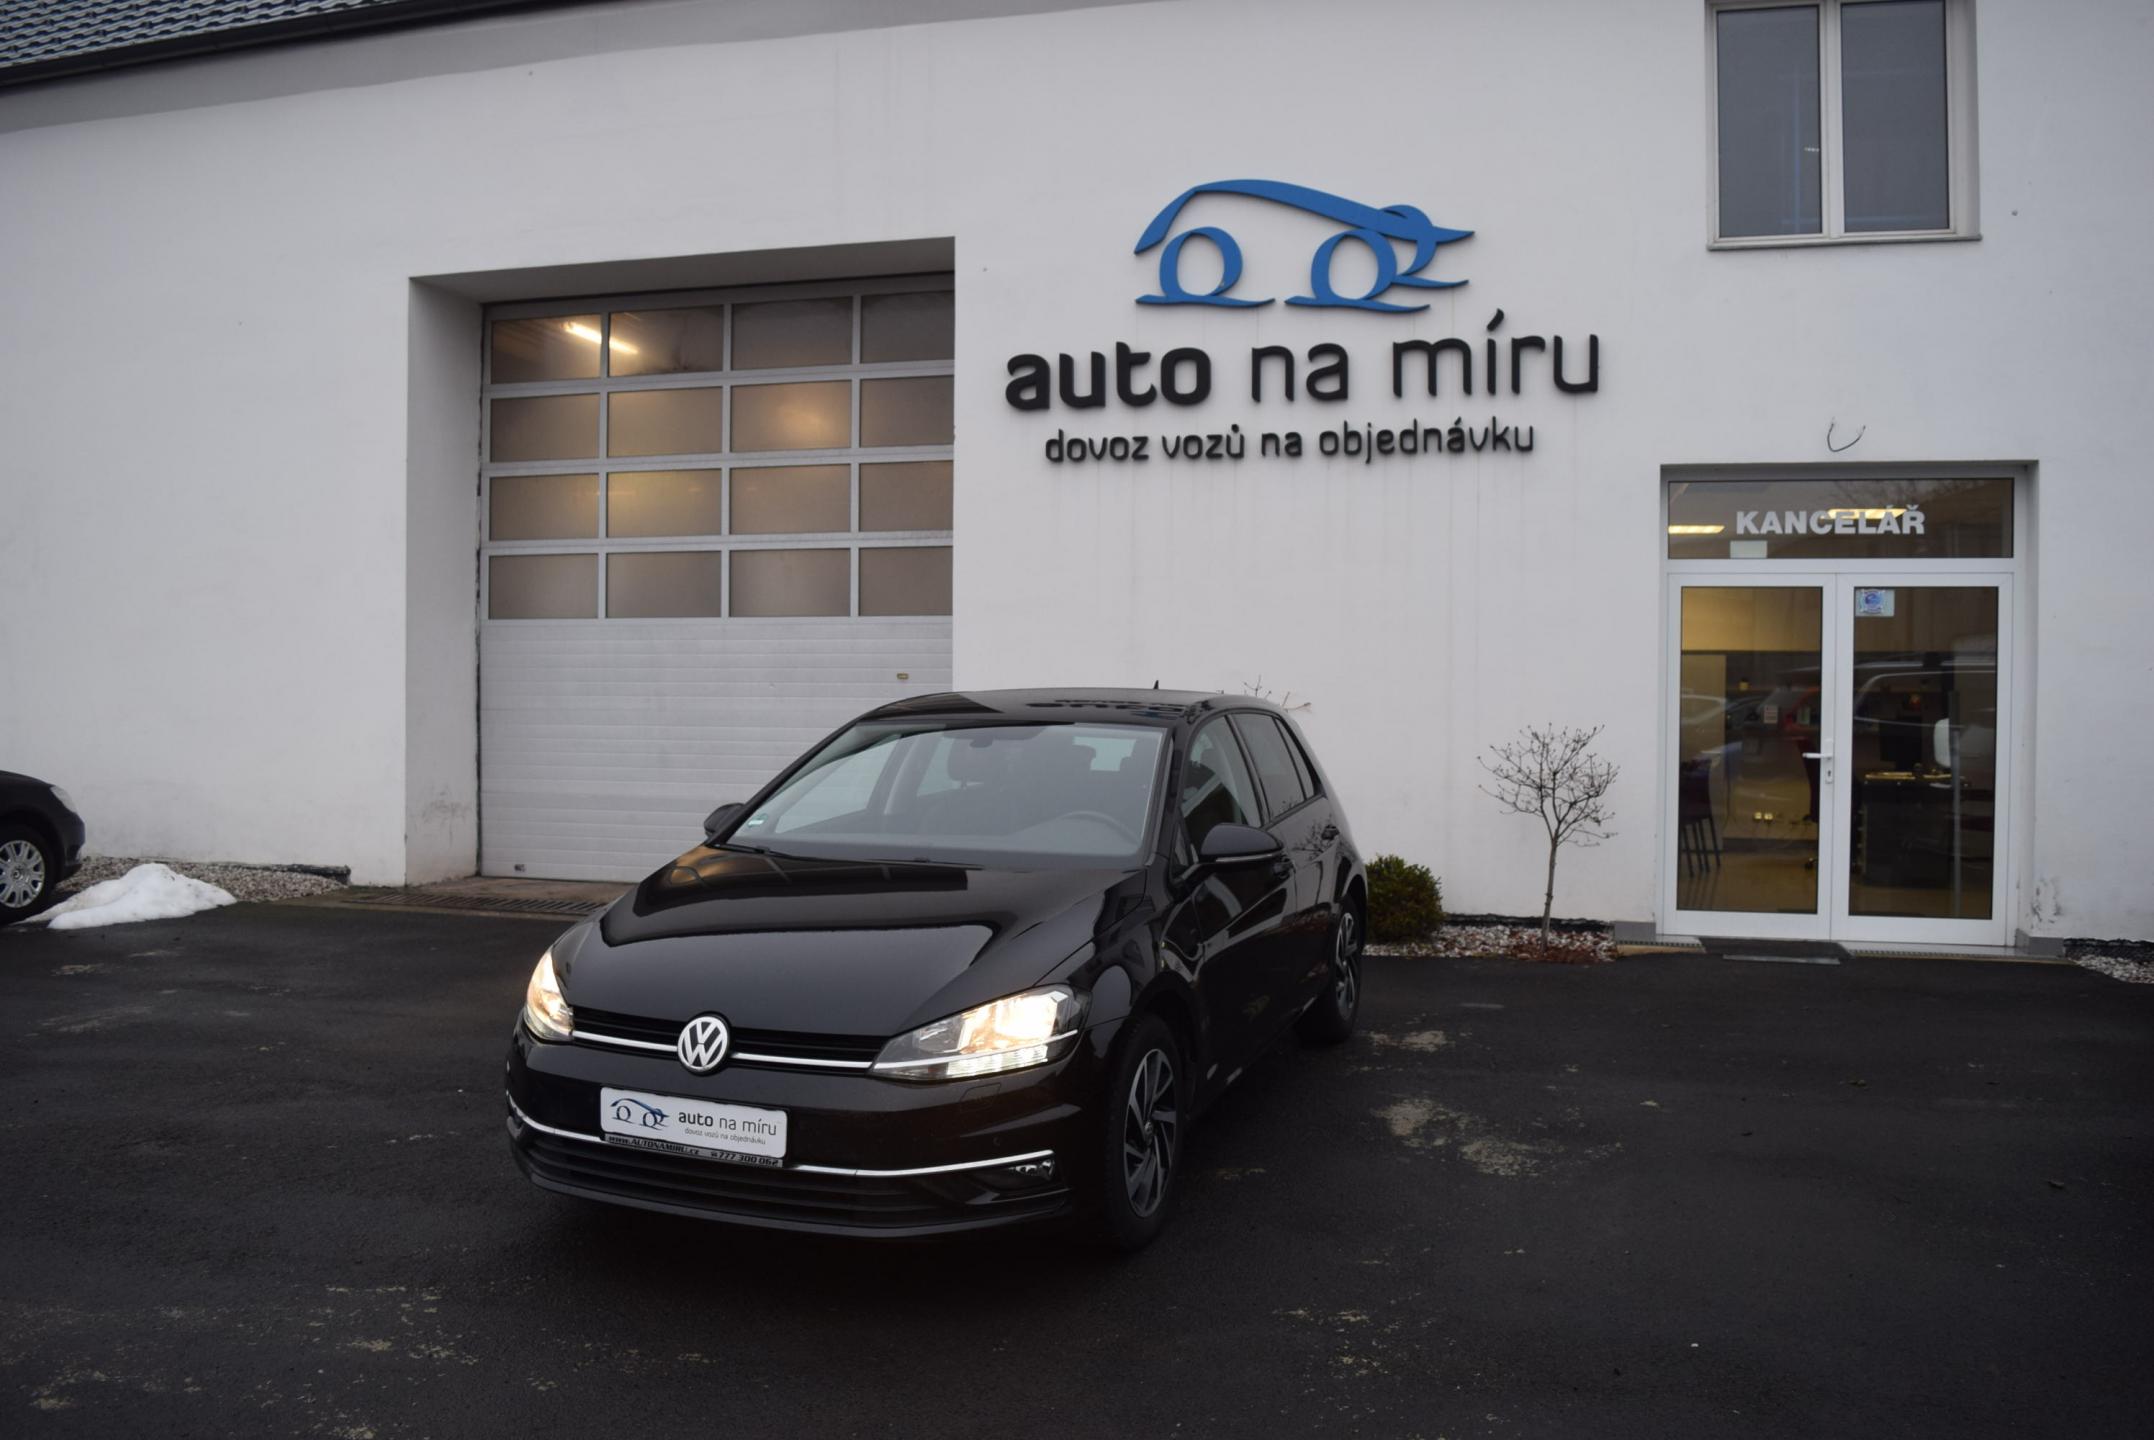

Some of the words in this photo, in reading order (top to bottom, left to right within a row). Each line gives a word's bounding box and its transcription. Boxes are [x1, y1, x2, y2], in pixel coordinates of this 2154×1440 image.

[1005, 341, 1211, 410] auto
[1252, 343, 1349, 402] na
[1393, 309, 1599, 398] míru
[1045, 429, 1149, 463] dovoz
[1162, 424, 1245, 460] vozů
[1261, 428, 1302, 458] na
[1319, 417, 1534, 464] objednávku
[1736, 504, 1925, 535] KANCELÁŘ
[678, 1112, 714, 1127] auto
[719, 1117, 737, 1130] na
[742, 1118, 777, 1136] míru
[685, 1127, 703, 1136] dovoz
